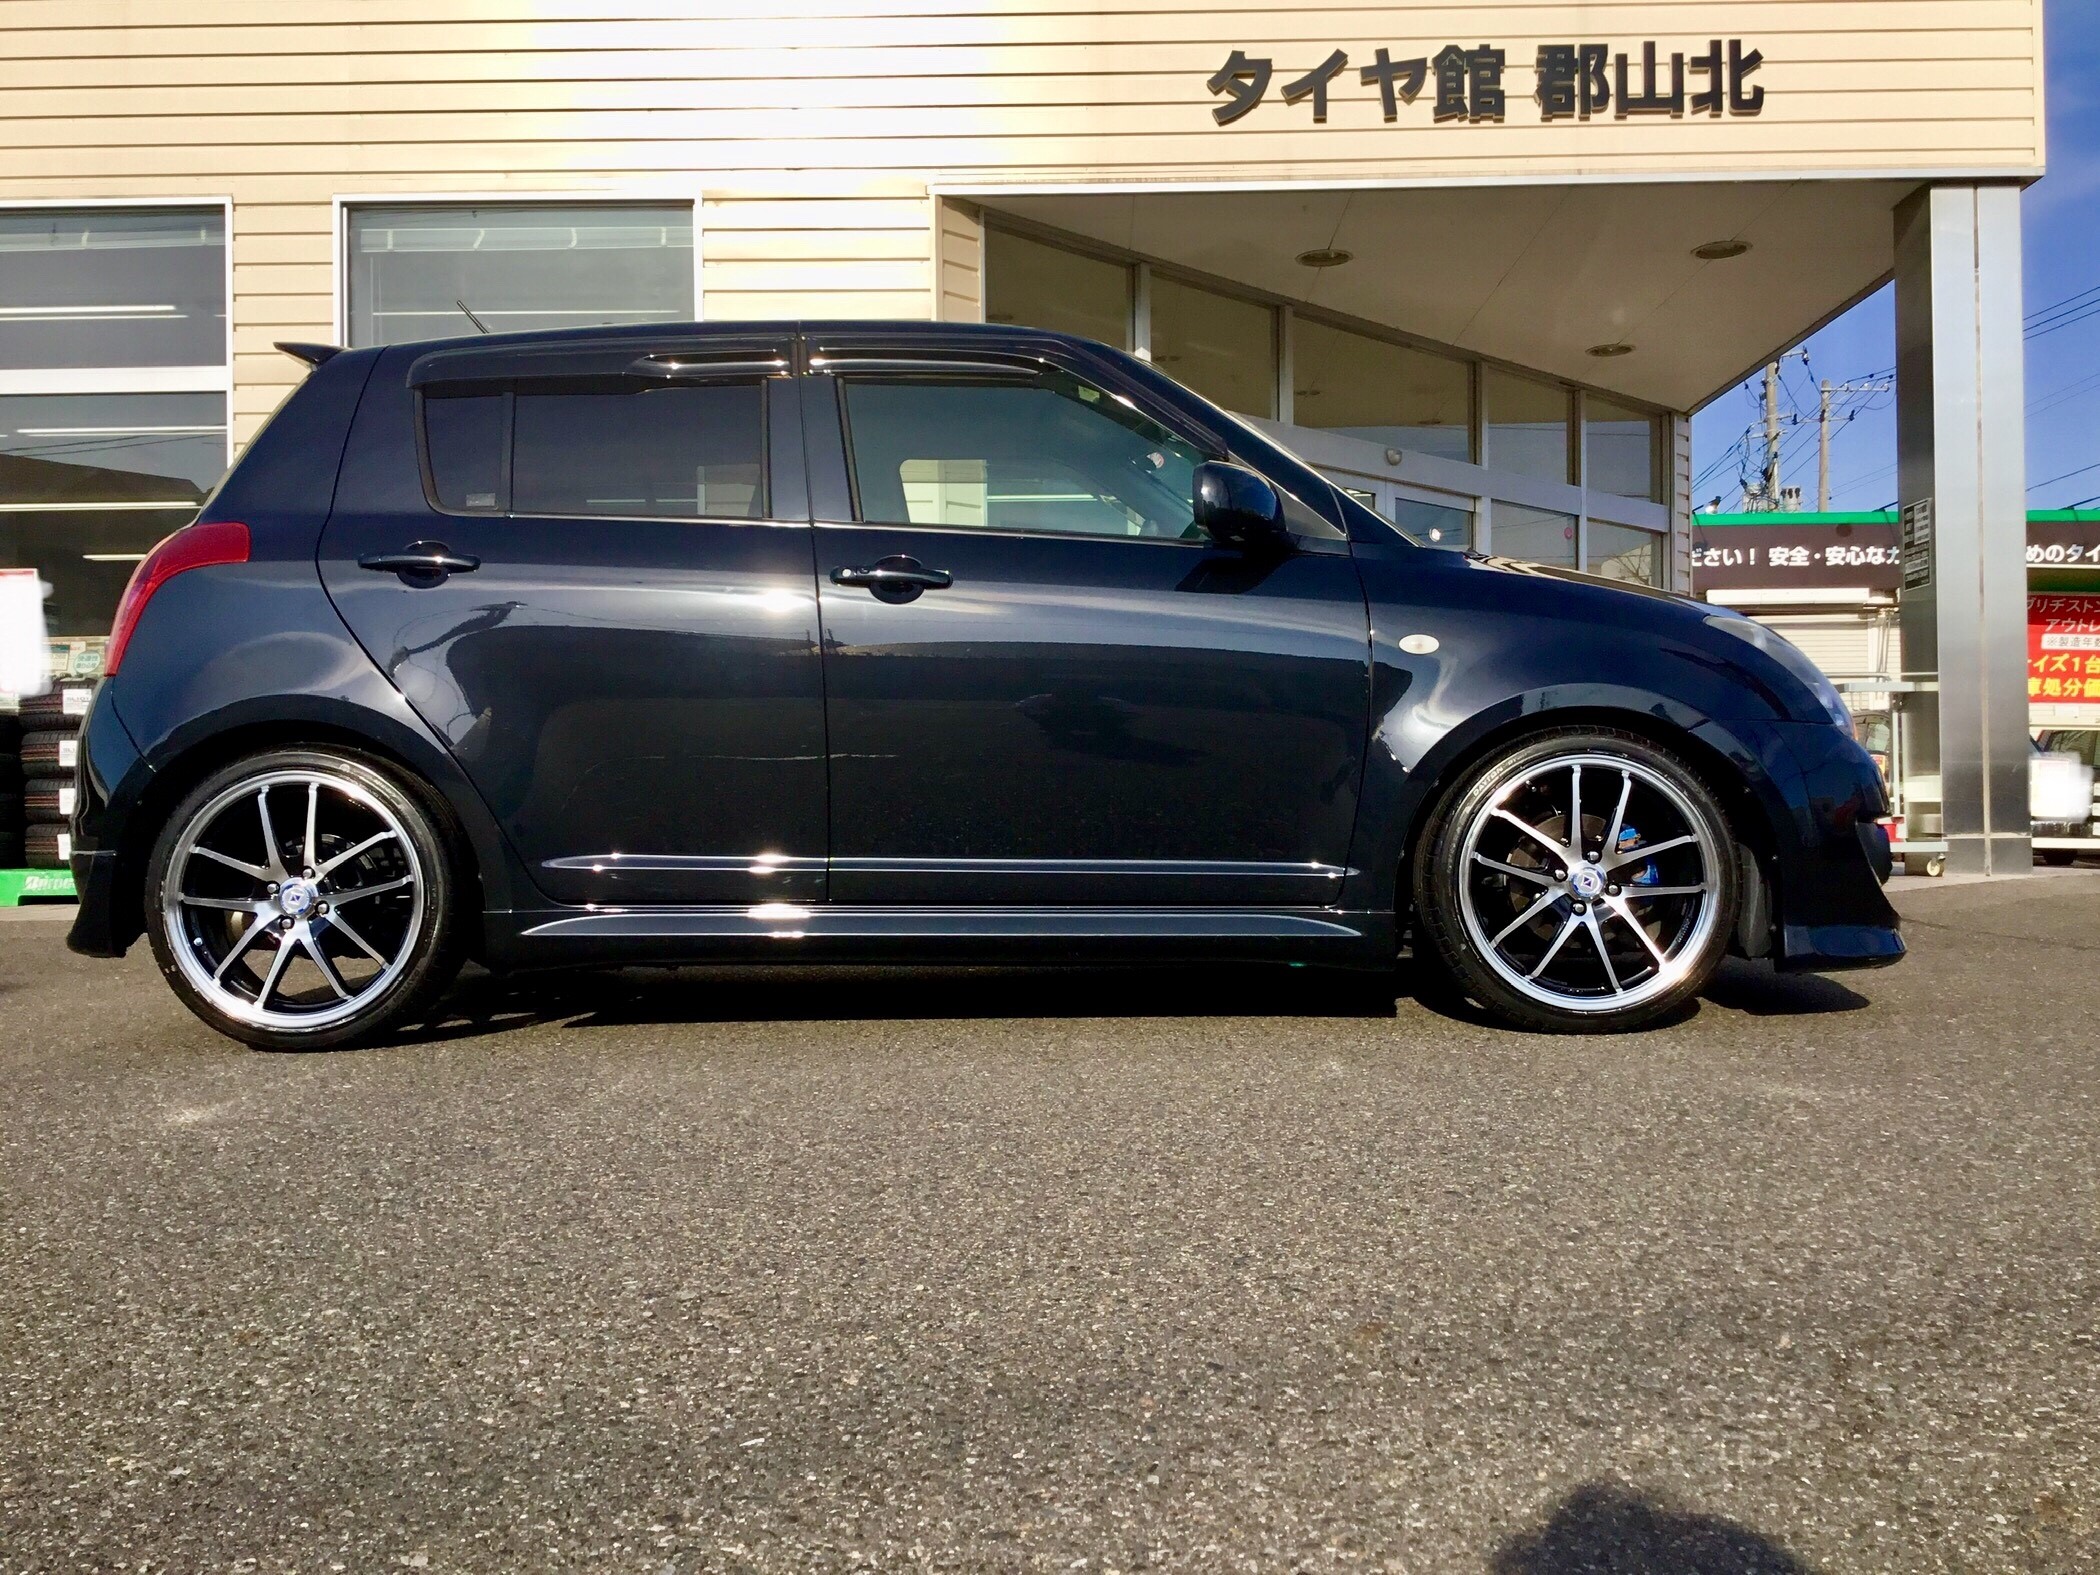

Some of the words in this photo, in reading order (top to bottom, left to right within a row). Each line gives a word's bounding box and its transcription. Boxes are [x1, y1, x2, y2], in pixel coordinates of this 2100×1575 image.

[1206, 44, 1505, 126] タイヤ館
[1534, 39, 1764, 122] 郡山北
[2045, 617, 2100, 633] アウトレ
[2027, 653, 2100, 674] イズ1台
[1473, 766, 1503, 796] DAYTON
